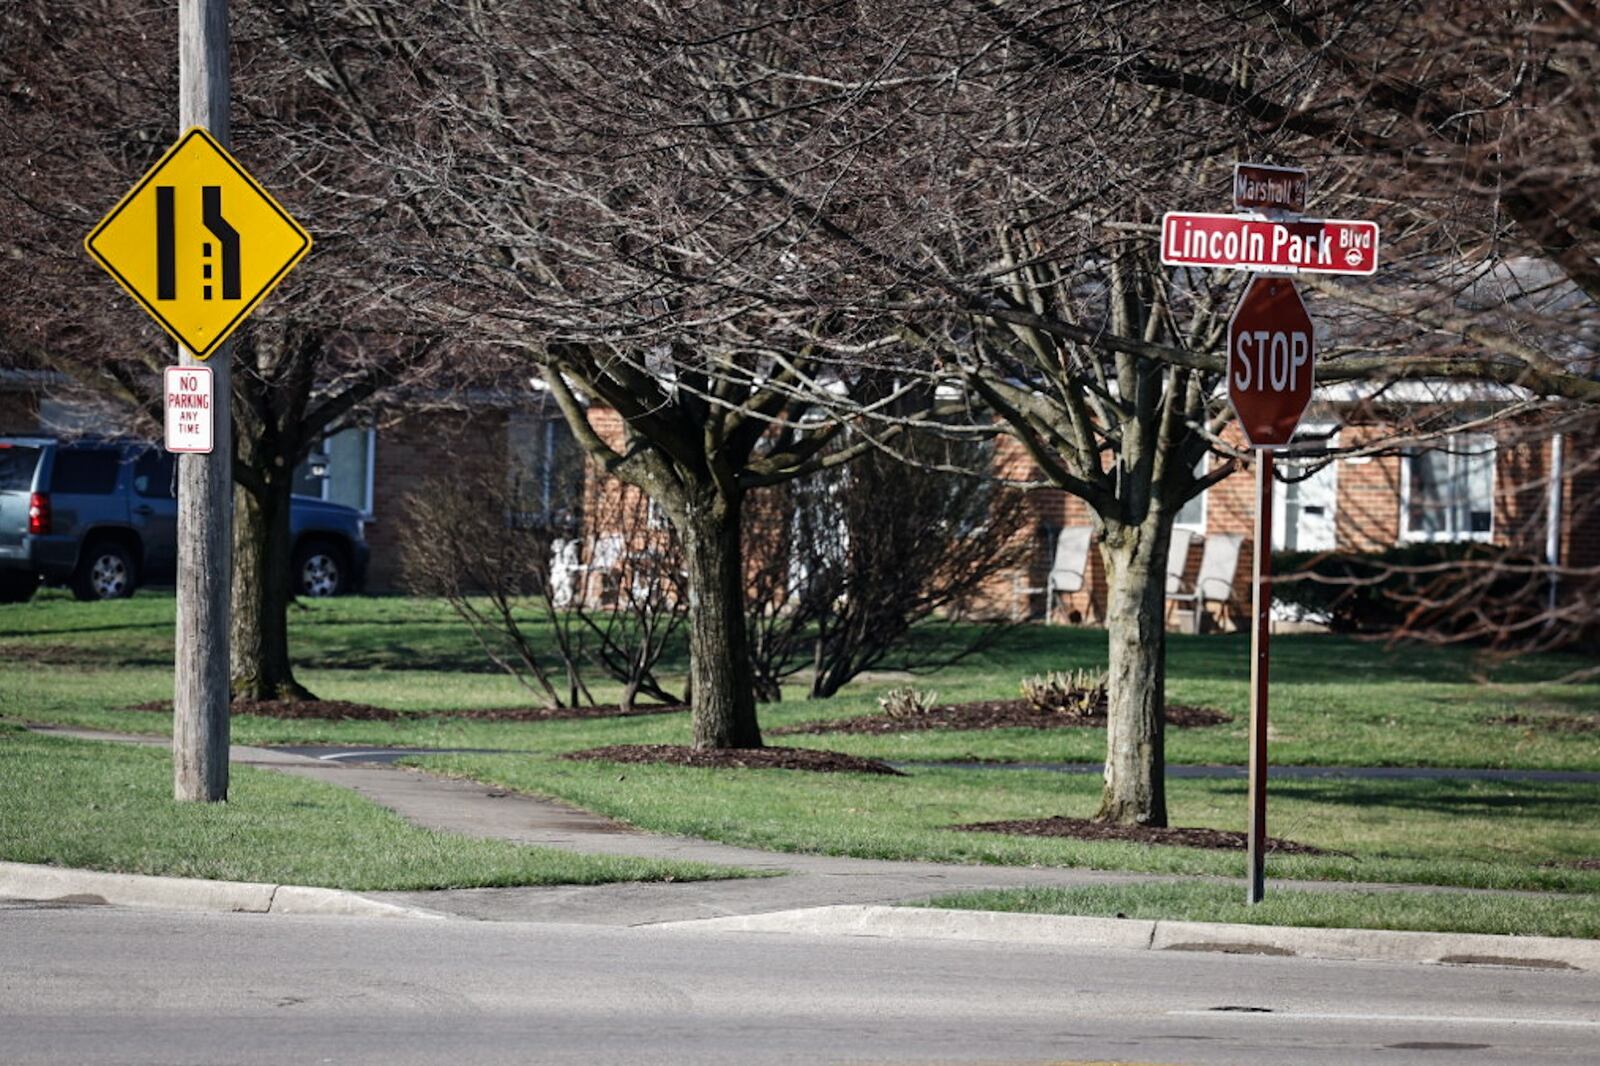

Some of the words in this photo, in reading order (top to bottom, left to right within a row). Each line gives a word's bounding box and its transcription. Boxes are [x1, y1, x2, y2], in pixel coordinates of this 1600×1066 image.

[1238, 174, 1292, 204] Marshall
[1168, 219, 1265, 262] Lincoln
[1271, 224, 1333, 265] Park
[1339, 227, 1371, 249] Blvd
[1235, 331, 1309, 392] STOP
[180, 376, 198, 391] NO
[168, 393, 209, 409] PARKING
[180, 411, 198, 421] ANY
[178, 423, 200, 434] TIME
